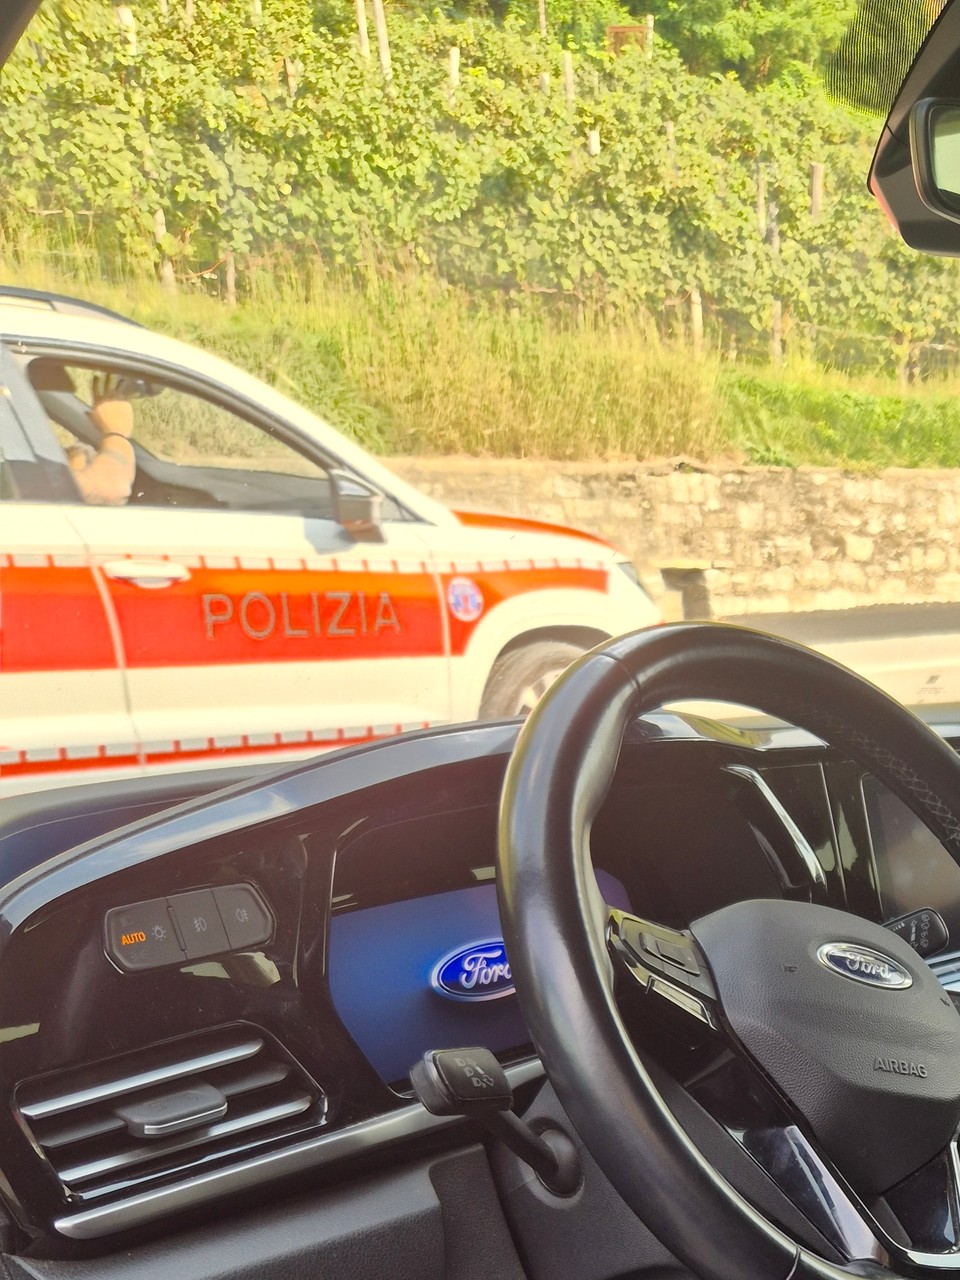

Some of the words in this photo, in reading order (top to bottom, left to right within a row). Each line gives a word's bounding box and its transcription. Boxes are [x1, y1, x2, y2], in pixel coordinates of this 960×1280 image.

[202, 590, 402, 640] POLIZIA
[121, 931, 146, 945] AUTO
[845, 951, 892, 979] Ford
[873, 1056, 928, 1079] AIRBAG
